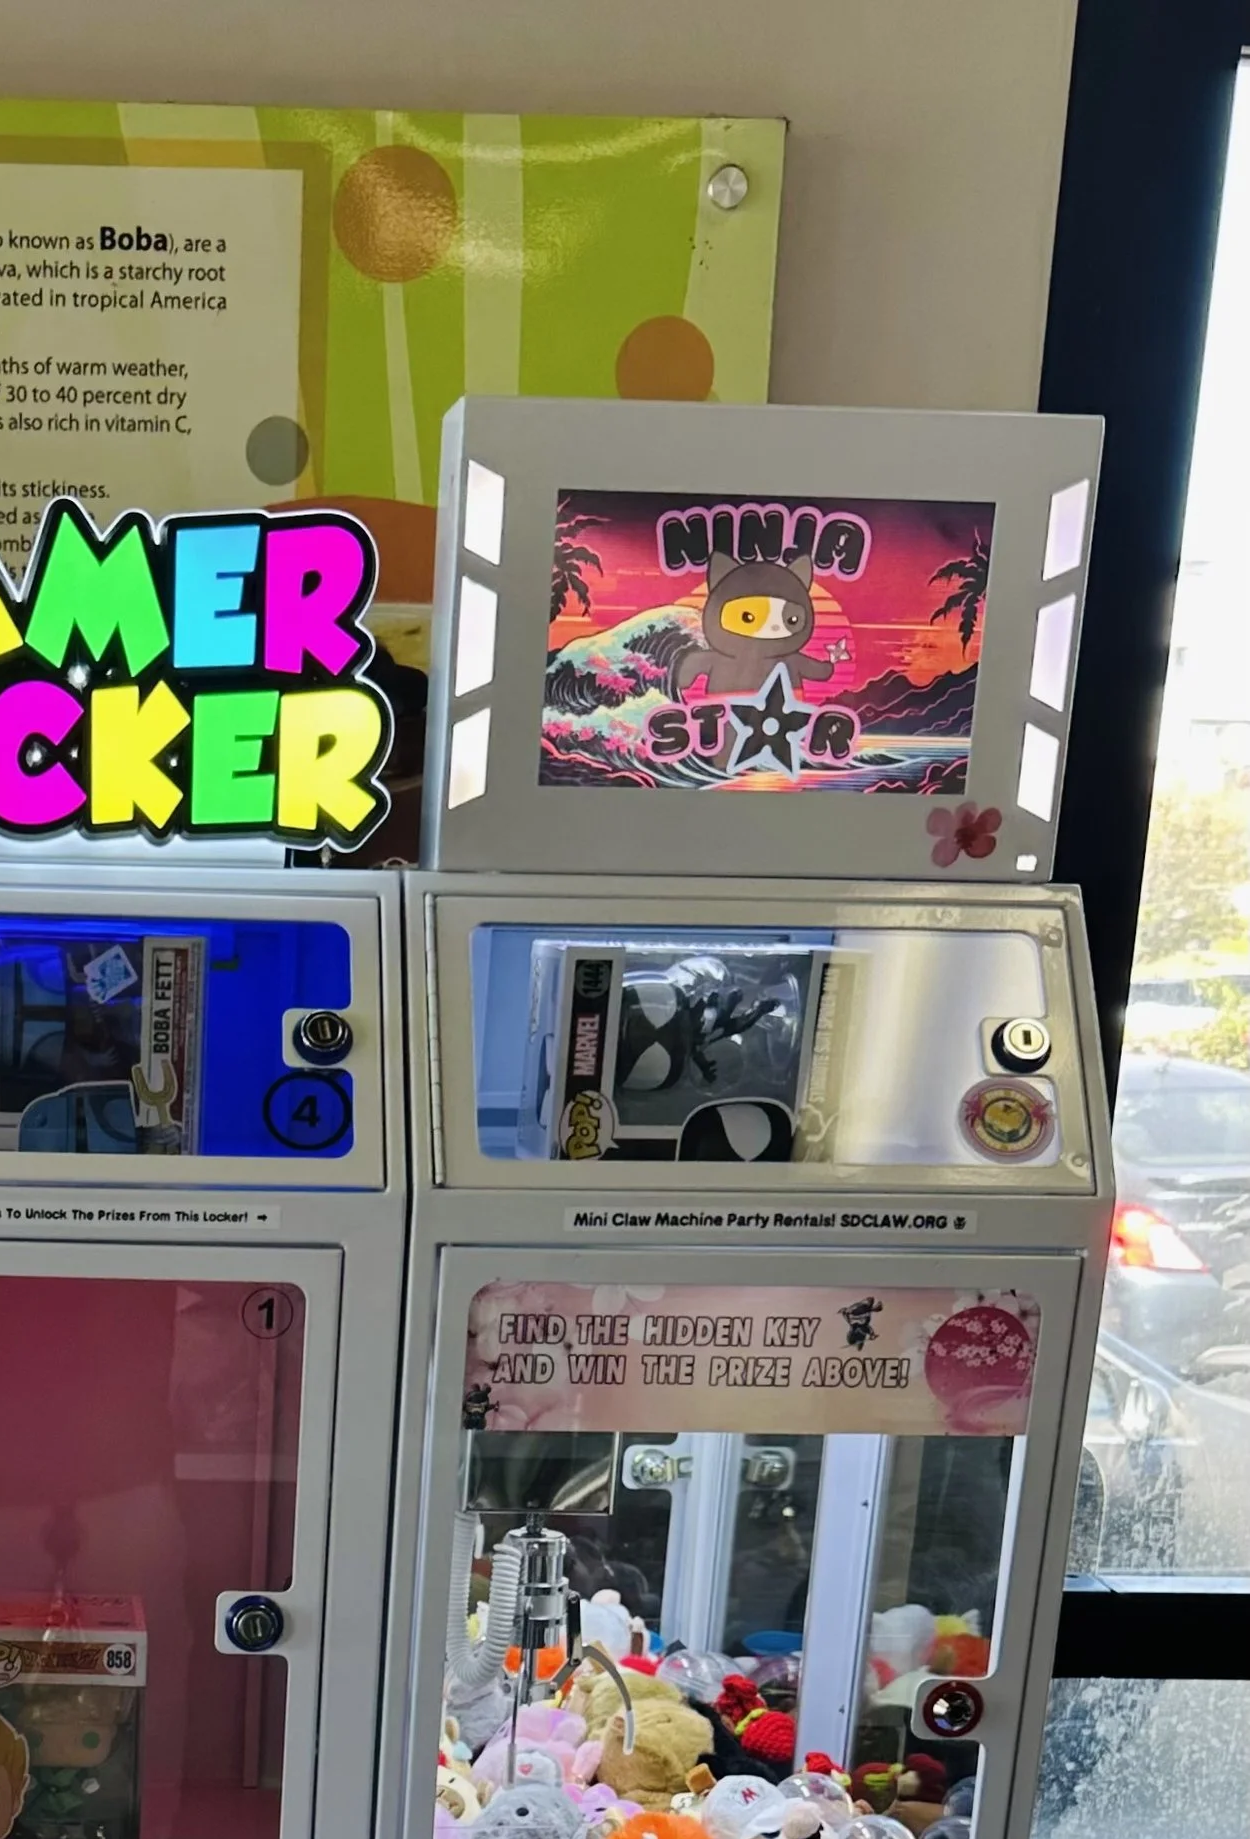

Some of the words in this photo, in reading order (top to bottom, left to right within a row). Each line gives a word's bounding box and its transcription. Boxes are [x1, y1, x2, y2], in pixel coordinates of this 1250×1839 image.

[9, 231, 69, 249] known
[76, 237, 94, 250] as
[100, 226, 177, 253] Boba),
[184, 239, 211, 252] are
[217, 240, 225, 252] a
[26, 260, 80, 278] which
[86, 263, 98, 279] is
[104, 266, 115, 279] a
[119, 263, 182, 284] starchy
[189, 266, 225, 281] root
[50, 290, 65, 306] in
[73, 290, 143, 312] tropical
[151, 291, 226, 310] America
[22, 480, 110, 498] stickiness.
[662, 508, 865, 575] NINJA
[155, 958, 174, 1001] FETT
[153, 1007, 171, 1054] BOBA
[573, 1013, 600, 1076] MARVEL
[292, 1095, 320, 1128] 4
[565, 1092, 603, 1160] POP!
[5, 1207, 22, 1220] To
[25, 1208, 67, 1220] Unlock
[71, 1209, 95, 1221] The
[97, 1209, 136, 1222] Prizes
[139, 1210, 171, 1222] From
[174, 1211, 200, 1223] This
[203, 1211, 248, 1223] Locker!
[573, 1212, 608, 1227] Mini
[611, 1212, 652, 1227] Claw
[654, 1212, 724, 1227] Machine
[726, 1212, 770, 1229] Party
[773, 1212, 836, 1227] Rentals!
[840, 1213, 948, 1230] SDCLAW.ORG
[257, 1299, 274, 1330] 1
[499, 1313, 566, 1344] FIND
[577, 1314, 629, 1345] THE
[643, 1316, 751, 1347] HIDDEN
[762, 1317, 820, 1349] KEY
[492, 1354, 554, 1384] AND
[568, 1355, 626, 1385] WIN
[641, 1356, 694, 1386] THE
[708, 1356, 791, 1388] PRIZE
[802, 1357, 911, 1388] ABOVE!
[106, 1650, 132, 1669] 858
